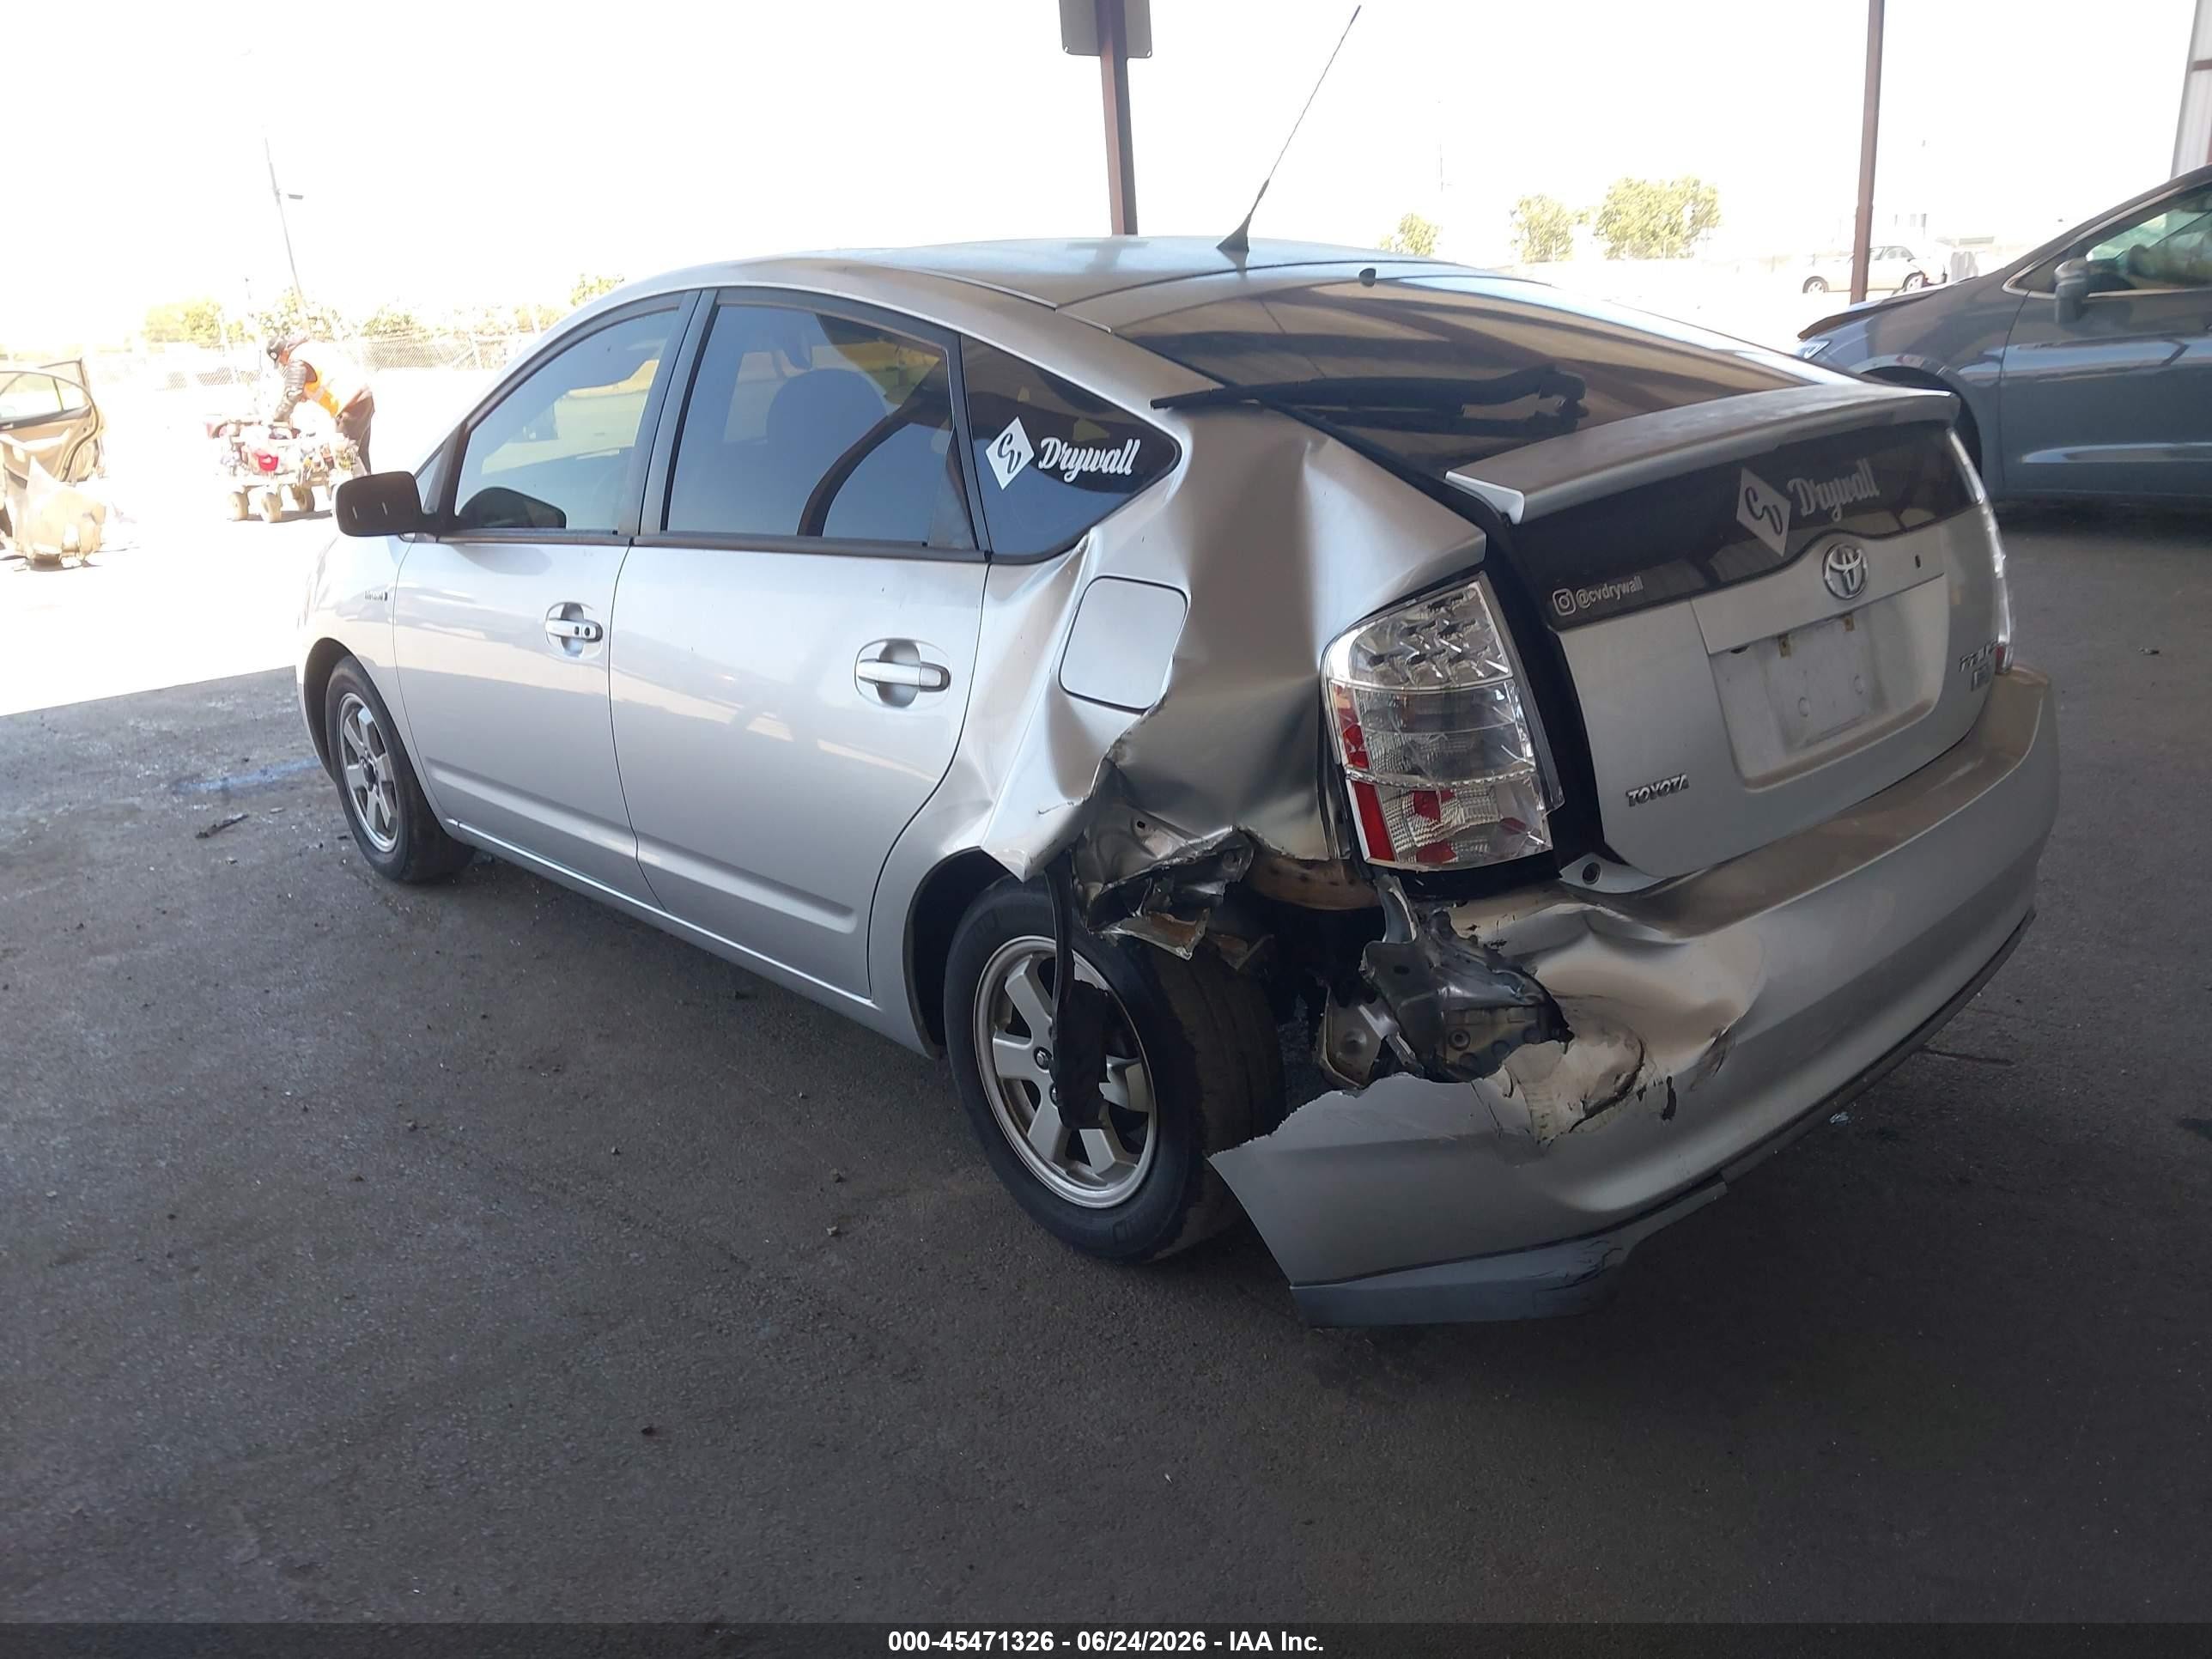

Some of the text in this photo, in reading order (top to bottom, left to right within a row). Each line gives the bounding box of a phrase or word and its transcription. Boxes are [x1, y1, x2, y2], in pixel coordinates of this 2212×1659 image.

[1037, 437, 1141, 483] Drywall
[1786, 458, 1881, 522] Drywall
[1576, 575, 1644, 609] @cvdrywall
[1626, 773, 1690, 807] TOYOTA
